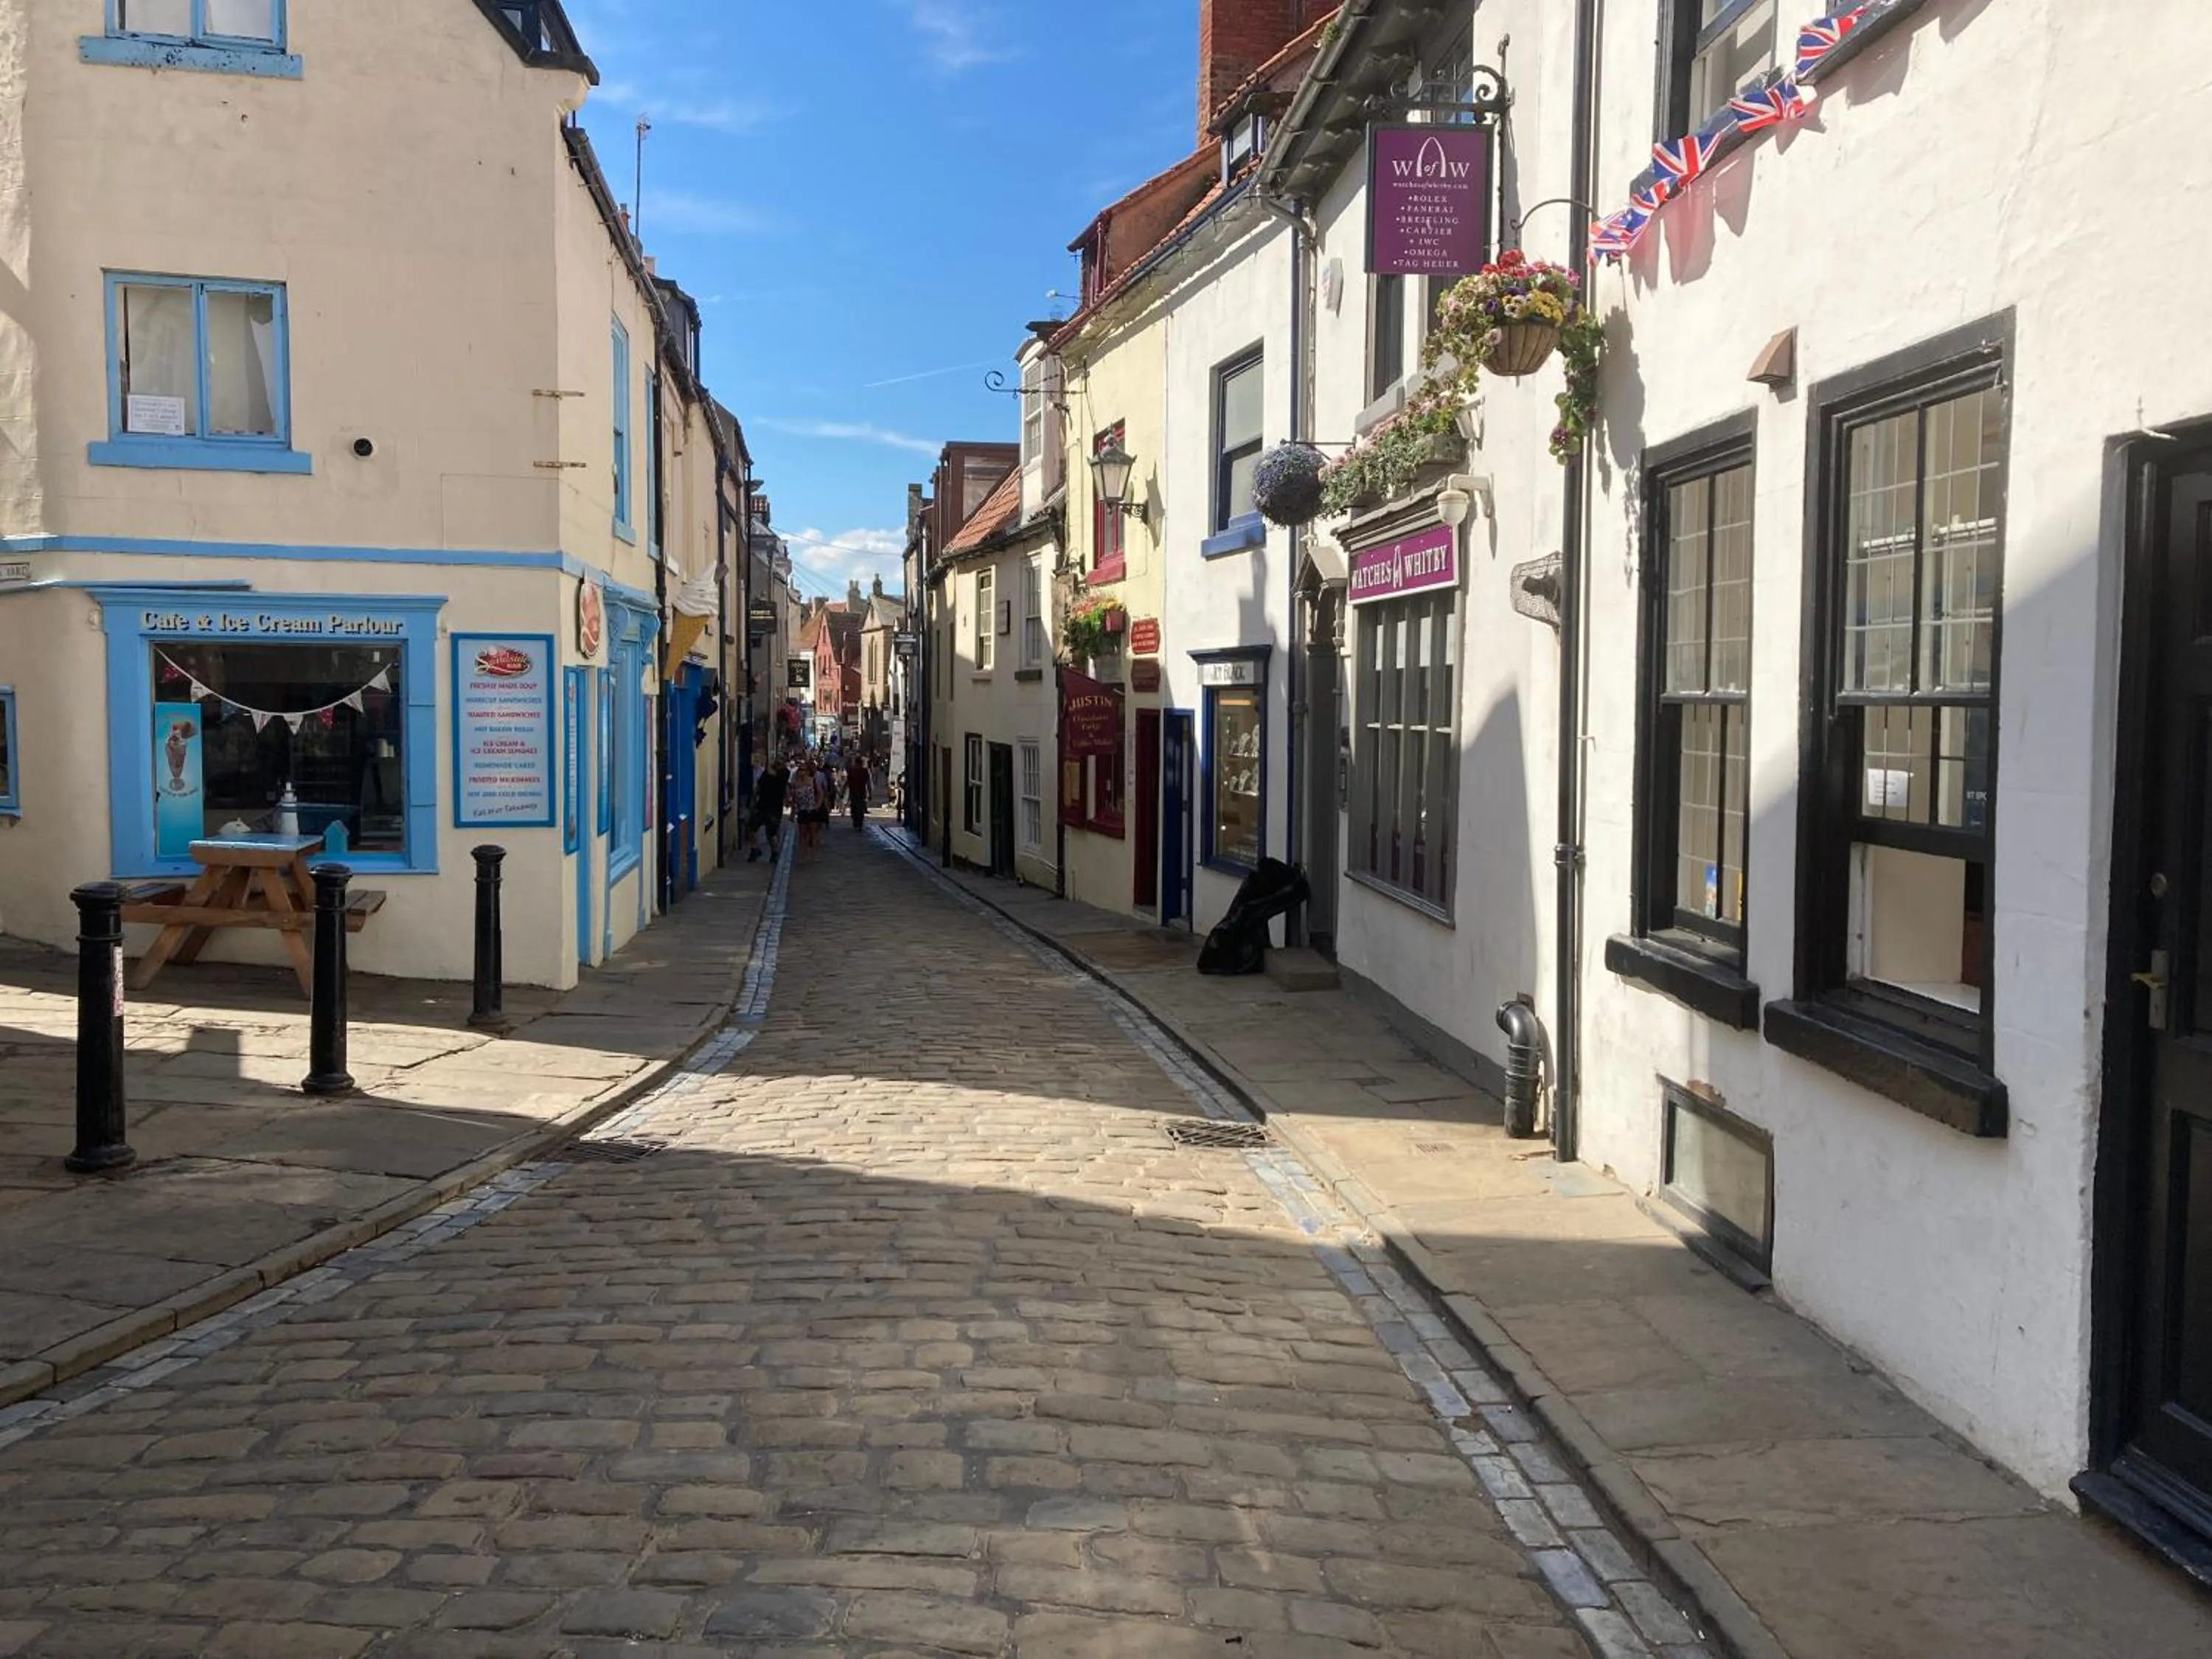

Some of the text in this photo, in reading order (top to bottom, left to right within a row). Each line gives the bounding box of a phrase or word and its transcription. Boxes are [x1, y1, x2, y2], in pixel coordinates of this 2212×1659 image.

[1392, 160, 1470, 178] W of W
[1413, 195, 1447, 203] ROLEX
[1401, 216, 1459, 224] BREITLING
[1407, 227, 1452, 235] CARTIER
[1409, 248, 1447, 257] OMEGA
[1398, 259, 1419, 267] TAG
[1352, 560, 1391, 590] WATCHES
[1404, 545, 1448, 578] WHITBY
[142, 612, 404, 636] Cafe & Ice Cream Parlour
[1069, 695, 1112, 712] JUSTIN
